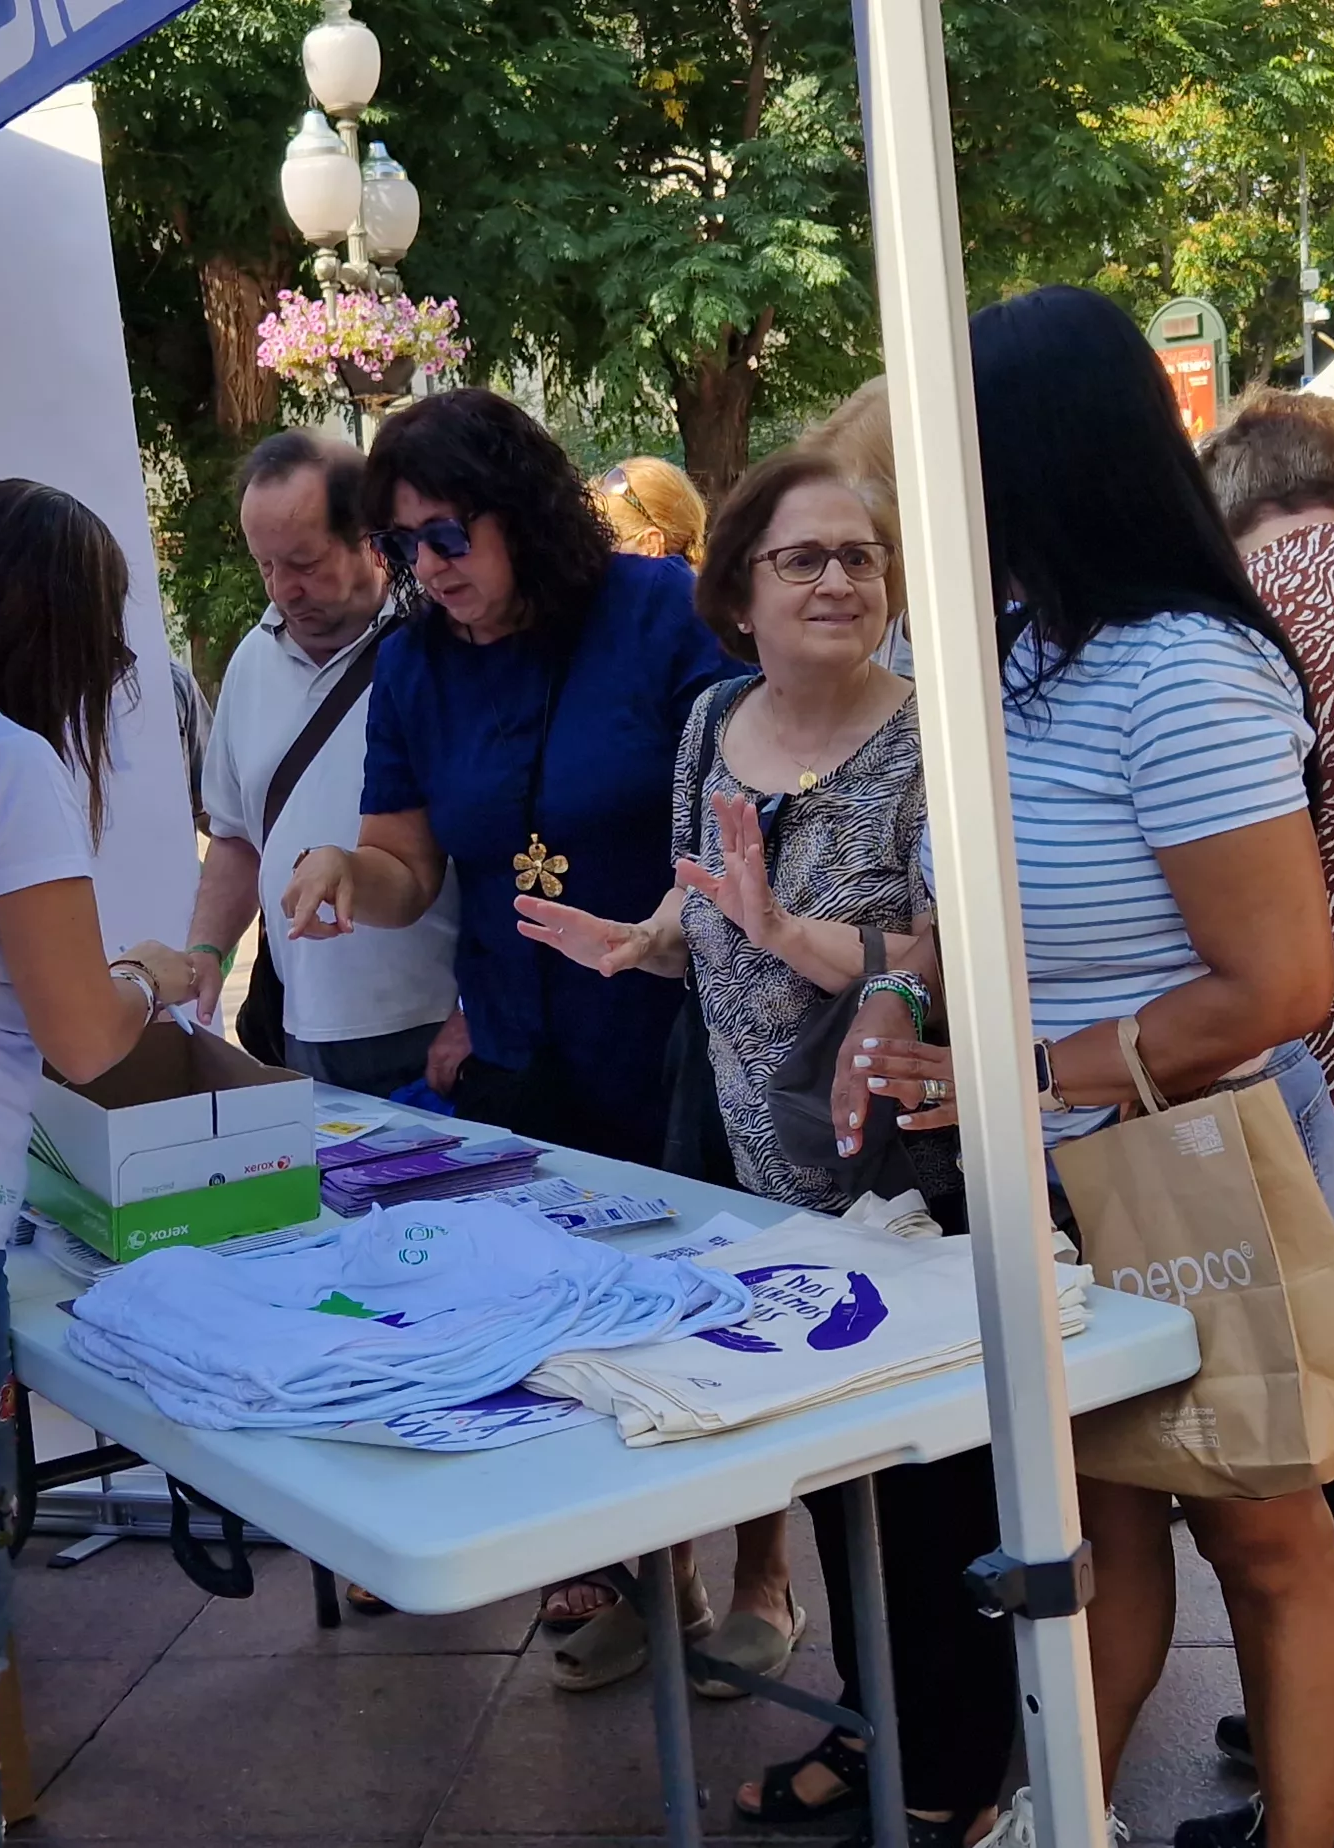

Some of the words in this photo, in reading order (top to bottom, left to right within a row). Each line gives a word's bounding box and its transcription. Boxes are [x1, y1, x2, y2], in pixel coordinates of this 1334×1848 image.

[244, 1160, 274, 1174] xerox
[149, 1224, 189, 1243] xerox
[784, 1274, 834, 1298] NOS
[1112, 1248, 1252, 1304] pepco
